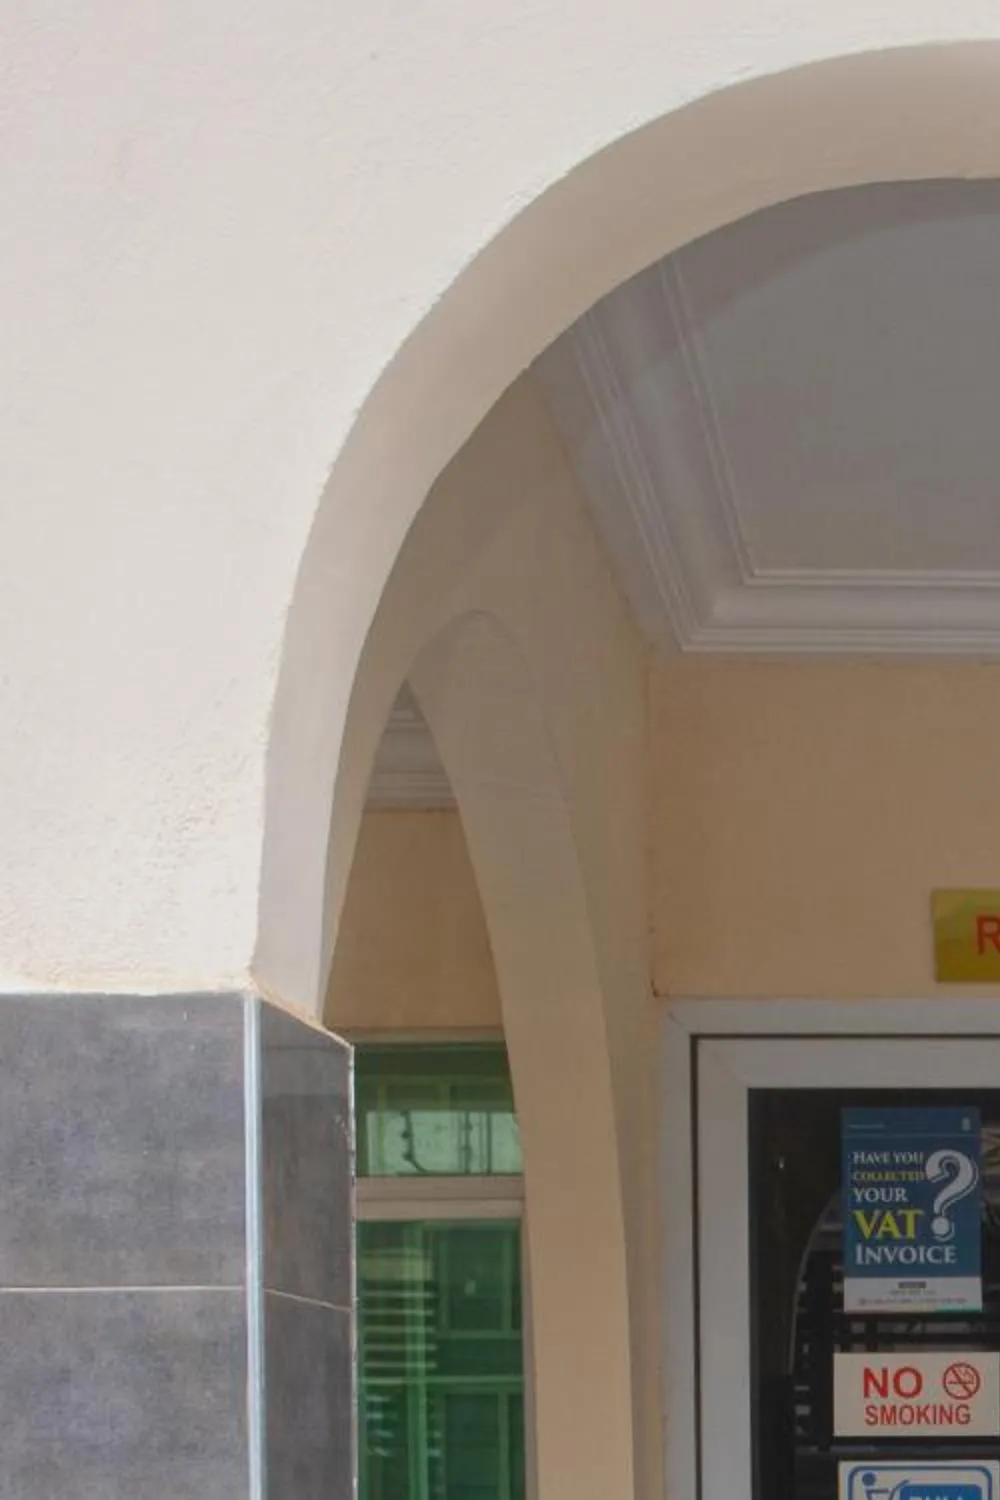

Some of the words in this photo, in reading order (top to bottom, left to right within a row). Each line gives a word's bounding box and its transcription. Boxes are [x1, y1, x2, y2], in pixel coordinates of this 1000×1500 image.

[852, 1151, 892, 1166] HAVE
[893, 1151, 924, 1165] YOU
[852, 1187, 909, 1203] YOUR
[852, 1208, 925, 1240] VAT
[855, 1245, 957, 1265] INVOICE
[863, 1366, 923, 1399] NO
[865, 1403, 971, 1426] SMOKING
